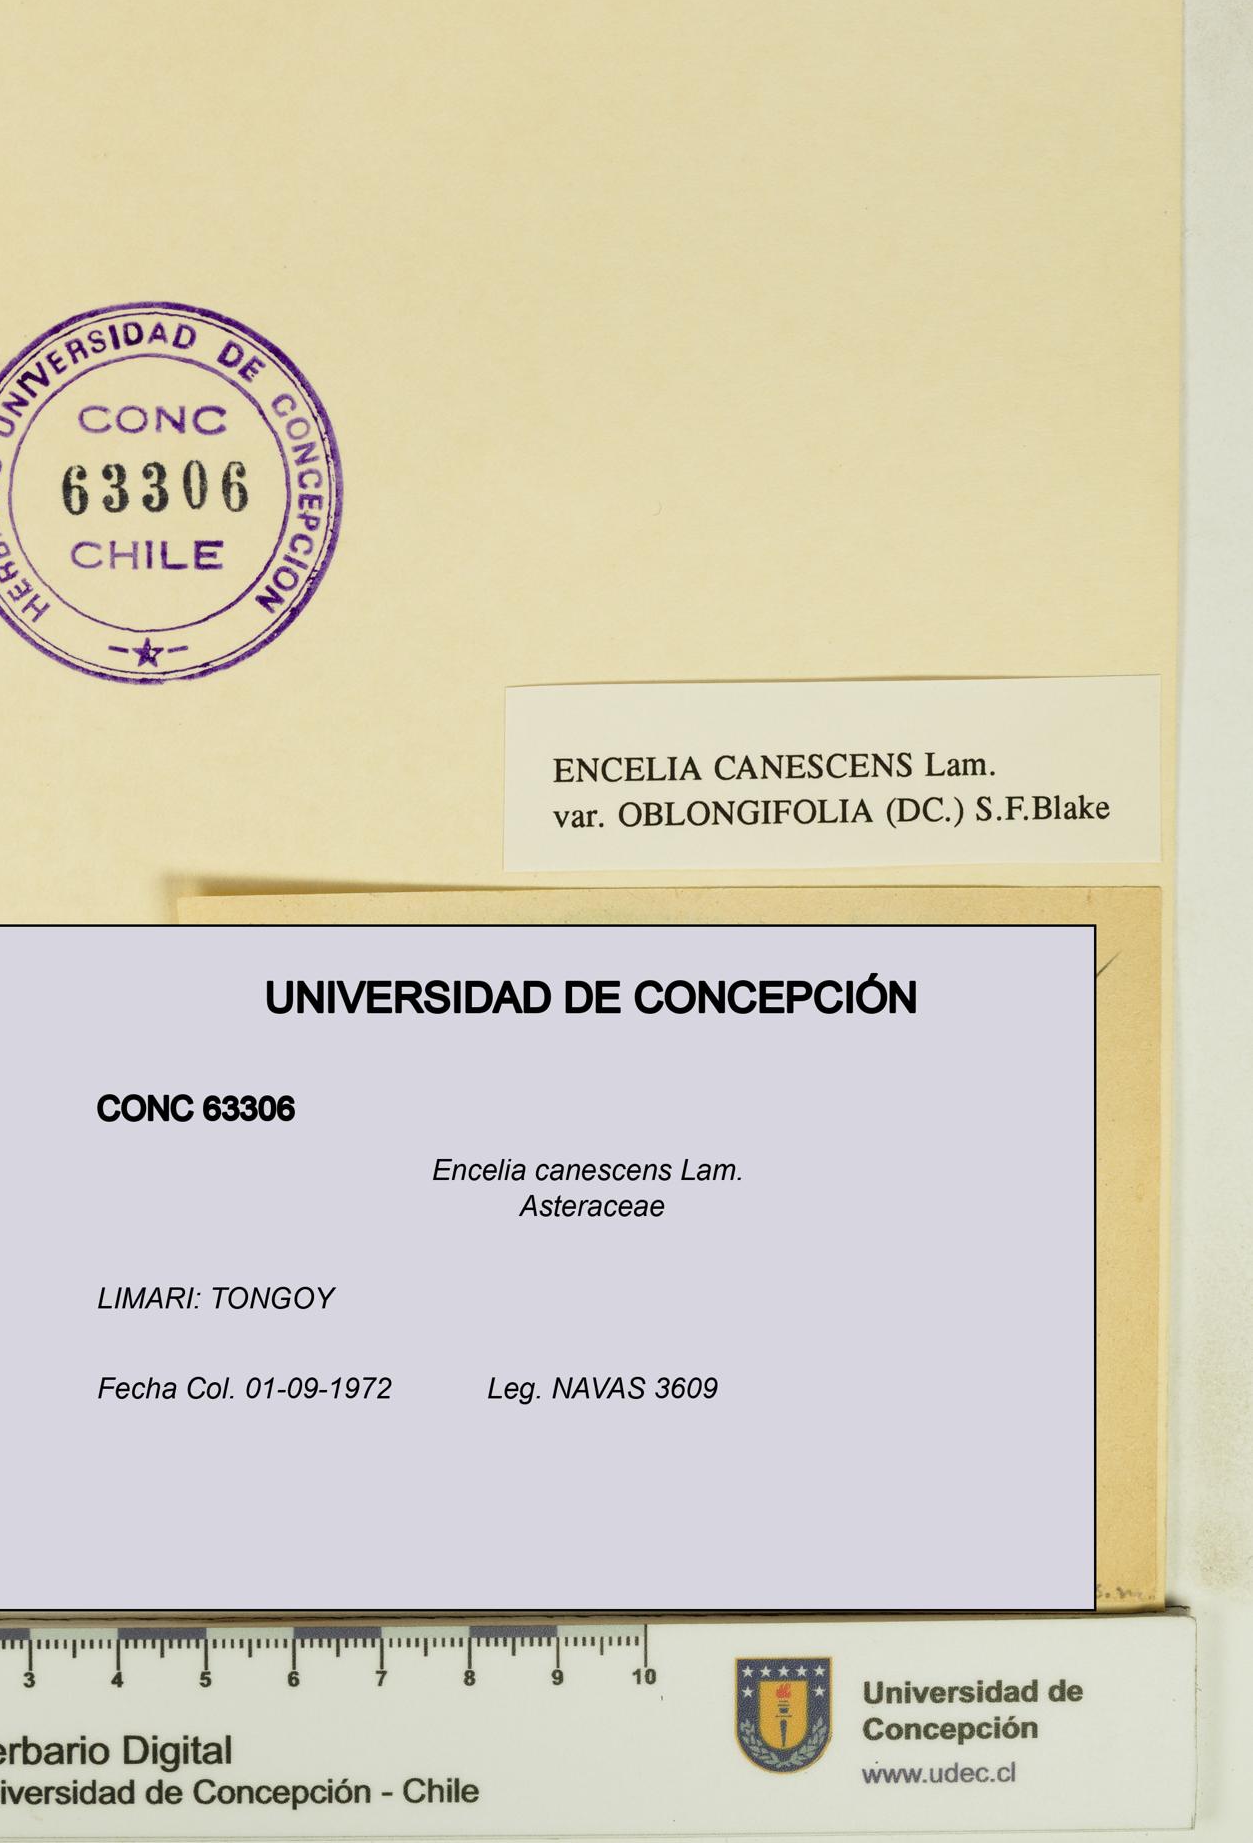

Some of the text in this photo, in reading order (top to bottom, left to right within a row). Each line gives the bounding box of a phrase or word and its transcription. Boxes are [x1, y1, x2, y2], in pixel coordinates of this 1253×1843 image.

[78, 406, 226, 435] CONC
[62, 460, 248, 515] 63306
[216, 339, 267, 383] DE
[255, 392, 324, 614] CONCEPCION
[71, 540, 223, 570] CHILE
[553, 753, 995, 782] ENCELIA CANESCENS Lam.
[553, 795, 1110, 828] var. OBLONGIFOLIA (DC.) S.F.Blake
[24, 1672, 35, 1688] 3
[111, 1672, 124, 1687] 4
[200, 1670, 211, 1687] 5
[288, 1671, 300, 1687] 6
[376, 1669, 387, 1686] 7
[464, 1670, 475, 1686] 8
[551, 1669, 563, 1685] 9
[633, 1669, 656, 1685] 10
[864, 1679, 1083, 1704] Universidad de
[863, 1716, 1038, 1745] Concepción
[124, 1735, 231, 1772] Digital
[862, 1763, 1015, 1784] www.udec.cl
[146, 1779, 183, 1805] de
[193, 1779, 371, 1810] Concepción
[403, 1778, 479, 1803] Chile
